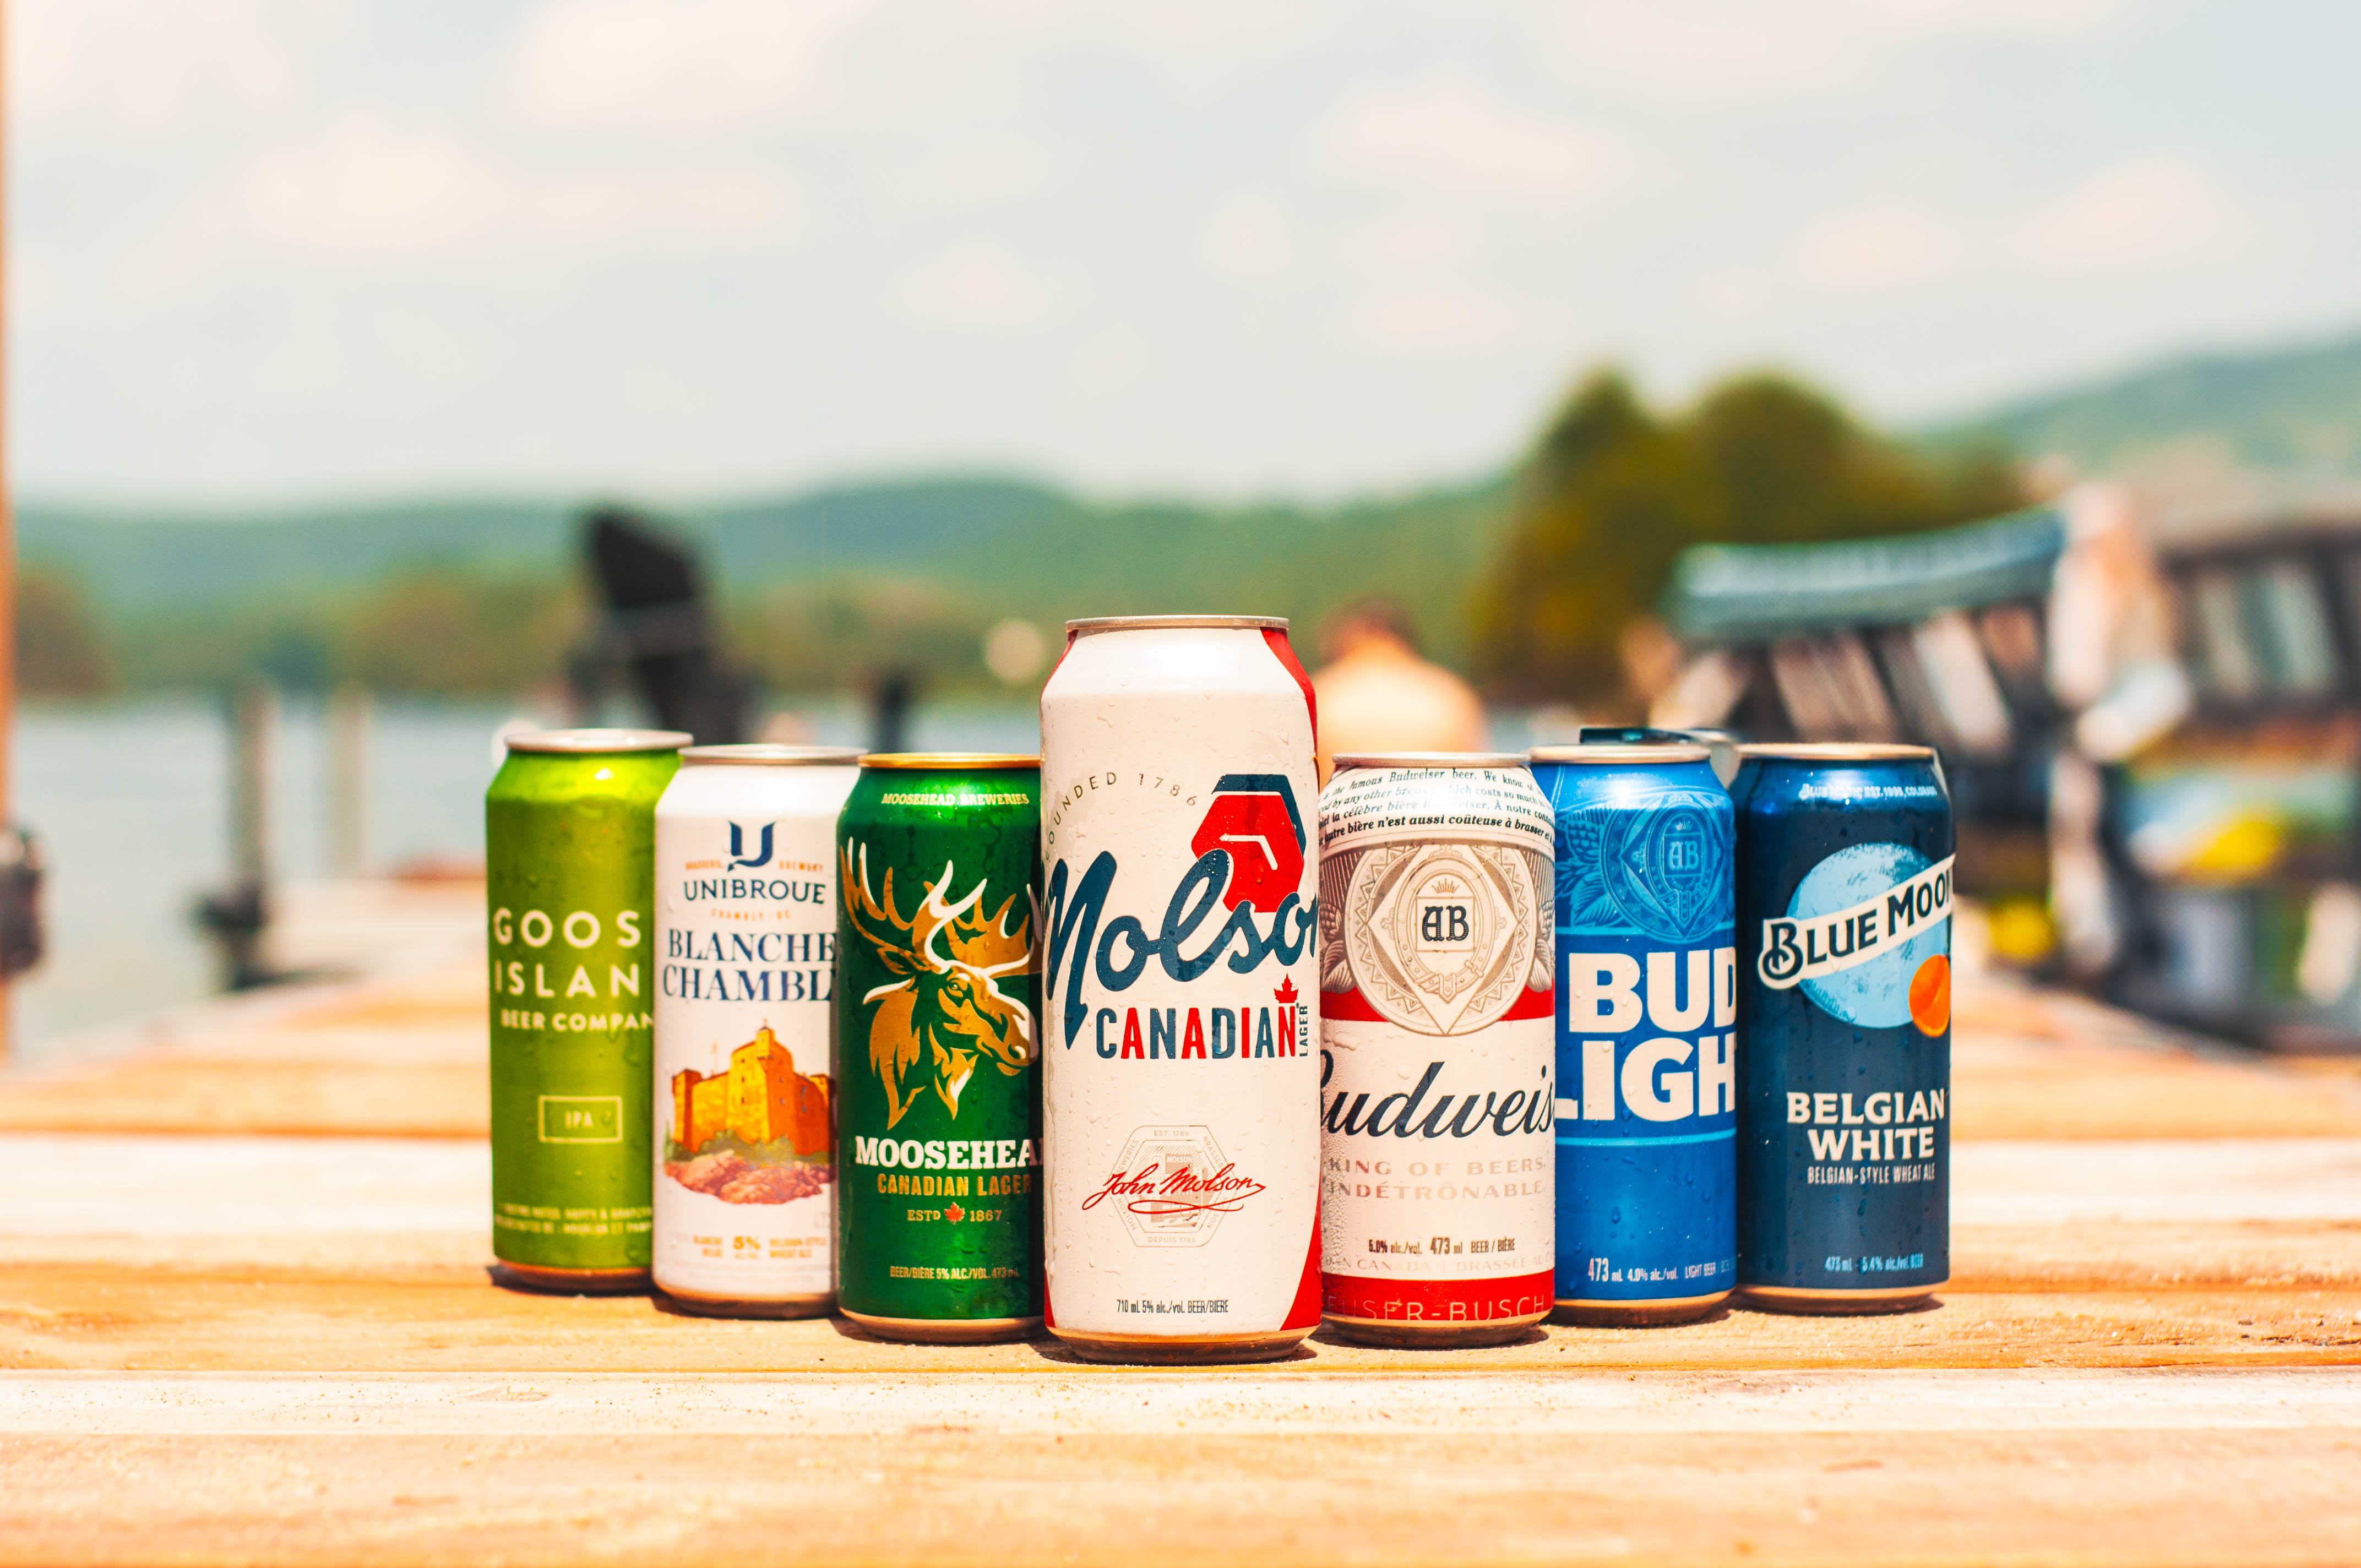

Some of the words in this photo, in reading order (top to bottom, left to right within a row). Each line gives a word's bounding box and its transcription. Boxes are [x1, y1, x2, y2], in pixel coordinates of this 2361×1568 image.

[1139, 773, 1197, 807] 1786
[1350, 776, 1383, 790] famous
[1389, 767, 1445, 782] Budweiser
[1452, 767, 1476, 780] beer.
[1484, 770, 1497, 782] We
[881, 793, 955, 805] MOOSEHEAD
[958, 793, 1030, 807] BREWERIES
[1343, 795, 1362, 807] any
[1364, 787, 1392, 799] other
[1476, 787, 1501, 797] costs
[1332, 813, 1340, 823] la
[1343, 803, 1383, 819] célèbre
[1388, 801, 1418, 812] bière
[1494, 798, 1502, 810] À
[1506, 804, 1531, 815] notre
[1348, 820, 1374, 834] bière
[1378, 816, 1406, 828] n'est
[1409, 814, 1445, 825] aussi
[1449, 814, 1503, 826] coûteuse
[1505, 817, 1511, 828] à
[1515, 819, 1544, 837] brasser
[684, 879, 826, 905] UNIBROUE
[494, 907, 641, 949] GOOS
[1422, 905, 1470, 942] AB
[668, 928, 836, 962] BLANCHE
[1762, 908, 1878, 980] BLUE
[495, 960, 640, 999] ISLAN
[663, 963, 836, 1002] CHAMBL
[1569, 946, 1737, 1033] BUD
[501, 1009, 546, 1031] BEER
[1299, 1005, 1308, 1057] LAGER
[1096, 1006, 1296, 1060] CANADIAN
[1786, 1088, 1945, 1124] BELGIAN
[565, 1110, 594, 1128] IPA
[1807, 1126, 1935, 1161] WHITE
[1329, 1157, 1392, 1175] KING
[1408, 1161, 1452, 1177] OF
[1467, 1157, 1543, 1176] BEERS
[1807, 1166, 1890, 1185] BELGIAN-STYLE
[1893, 1164, 1922, 1184] WHEAT
[1923, 1162, 1935, 1181] ALE
[877, 1173, 969, 1196] CANADIAN
[977, 1174, 1032, 1196] LAGER
[1082, 1163, 1158, 1210] John
[1156, 1163, 1266, 1205] Molson
[907, 1209, 941, 1222] ESTD
[970, 1209, 1002, 1223] 1867
[1369, 1239, 1388, 1253] 5.0%
[1430, 1237, 1450, 1255] 473
[1471, 1240, 1489, 1254] BEER
[1498, 1235, 1516, 1252] BIÈRE
[890, 1266, 935, 1279] BEER/BIÈRE
[935, 1267, 950, 1280] 5%
[992, 1267, 1007, 1278] 473
[1588, 1257, 1609, 1282] 473
[1627, 1267, 1649, 1282] 4.0%
[1684, 1264, 1702, 1279] LIGHT
[1704, 1262, 1717, 1276] BEER
[1824, 1256, 1841, 1272] 473
[1117, 1299, 1128, 1313] 710
[1130, 1299, 1140, 1313] mL
[1142, 1300, 1154, 1314] 5%
